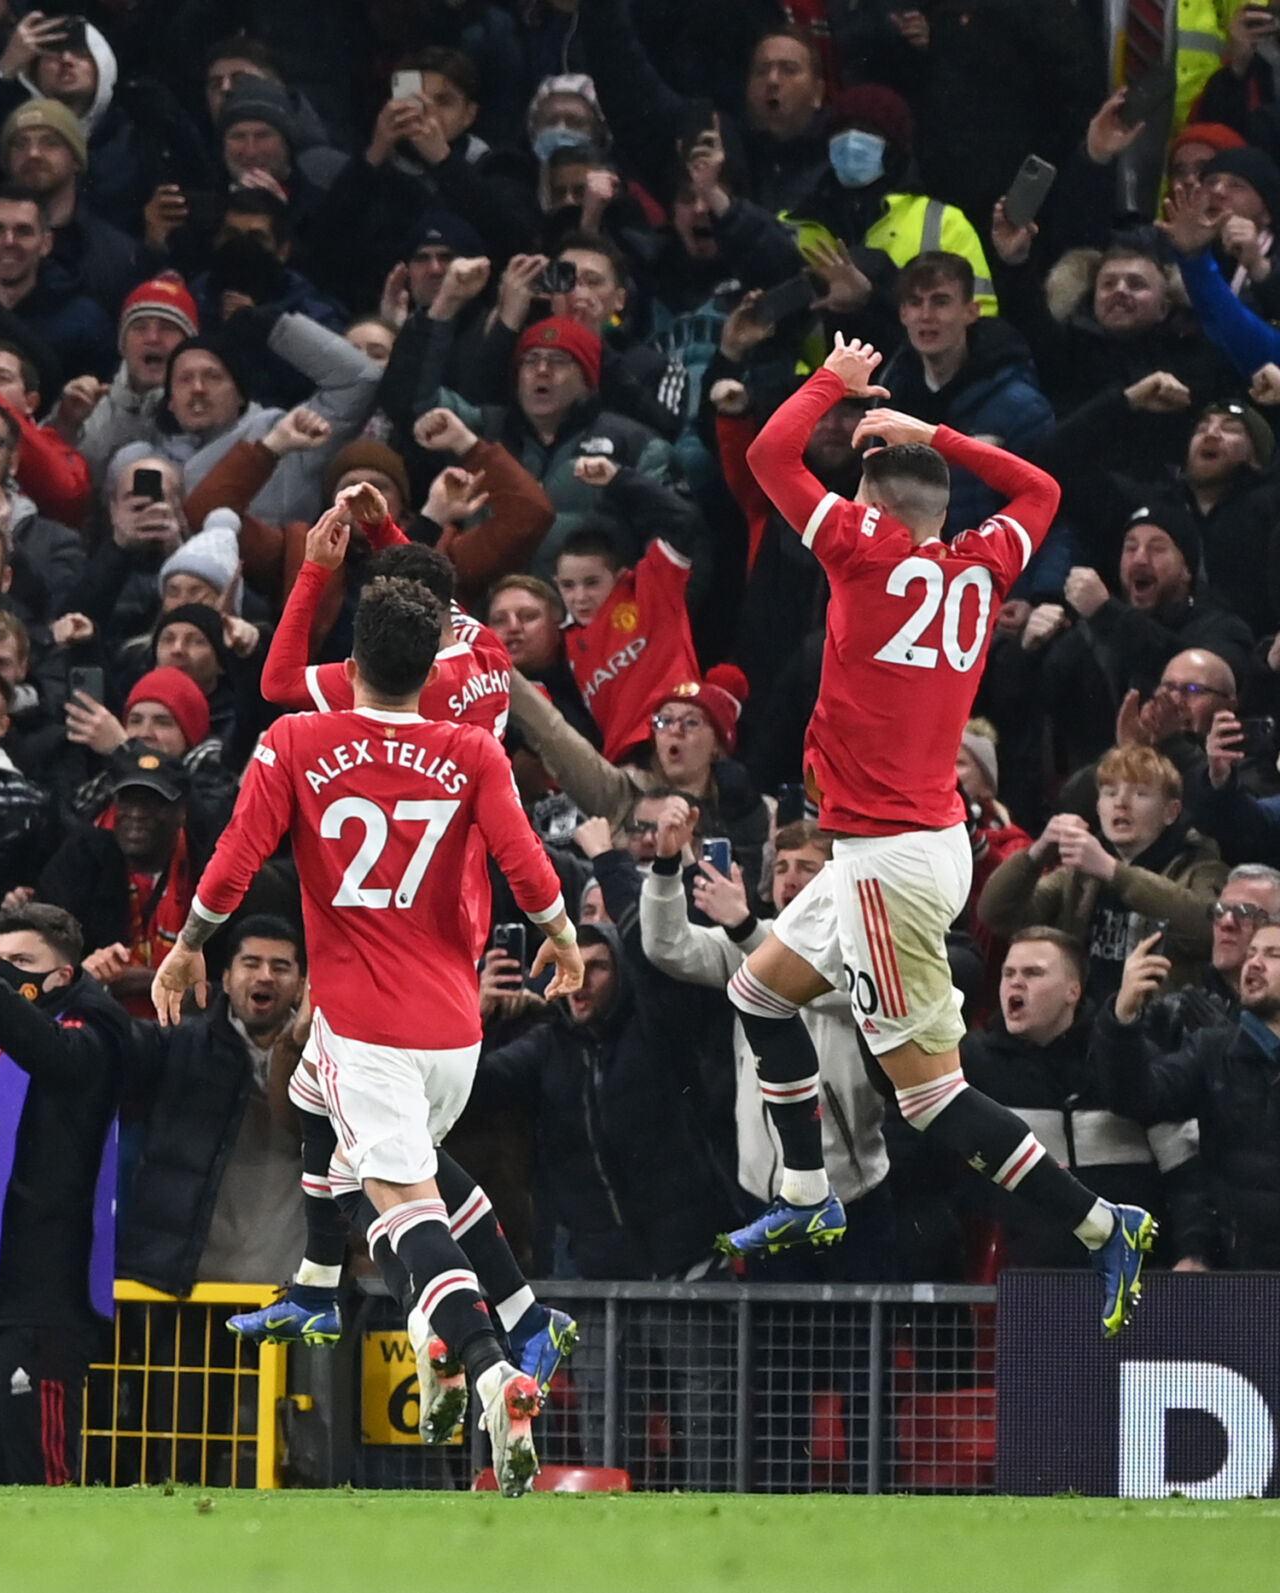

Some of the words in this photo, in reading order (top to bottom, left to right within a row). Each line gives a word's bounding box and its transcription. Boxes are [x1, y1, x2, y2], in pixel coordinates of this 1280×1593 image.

[873, 556, 993, 672] 20
[448, 669, 510, 717] SANCHO
[305, 739, 374, 794] ALEX
[383, 740, 468, 794] TELLES
[320, 796, 462, 908] 27
[1119, 1361, 1274, 1500] D
